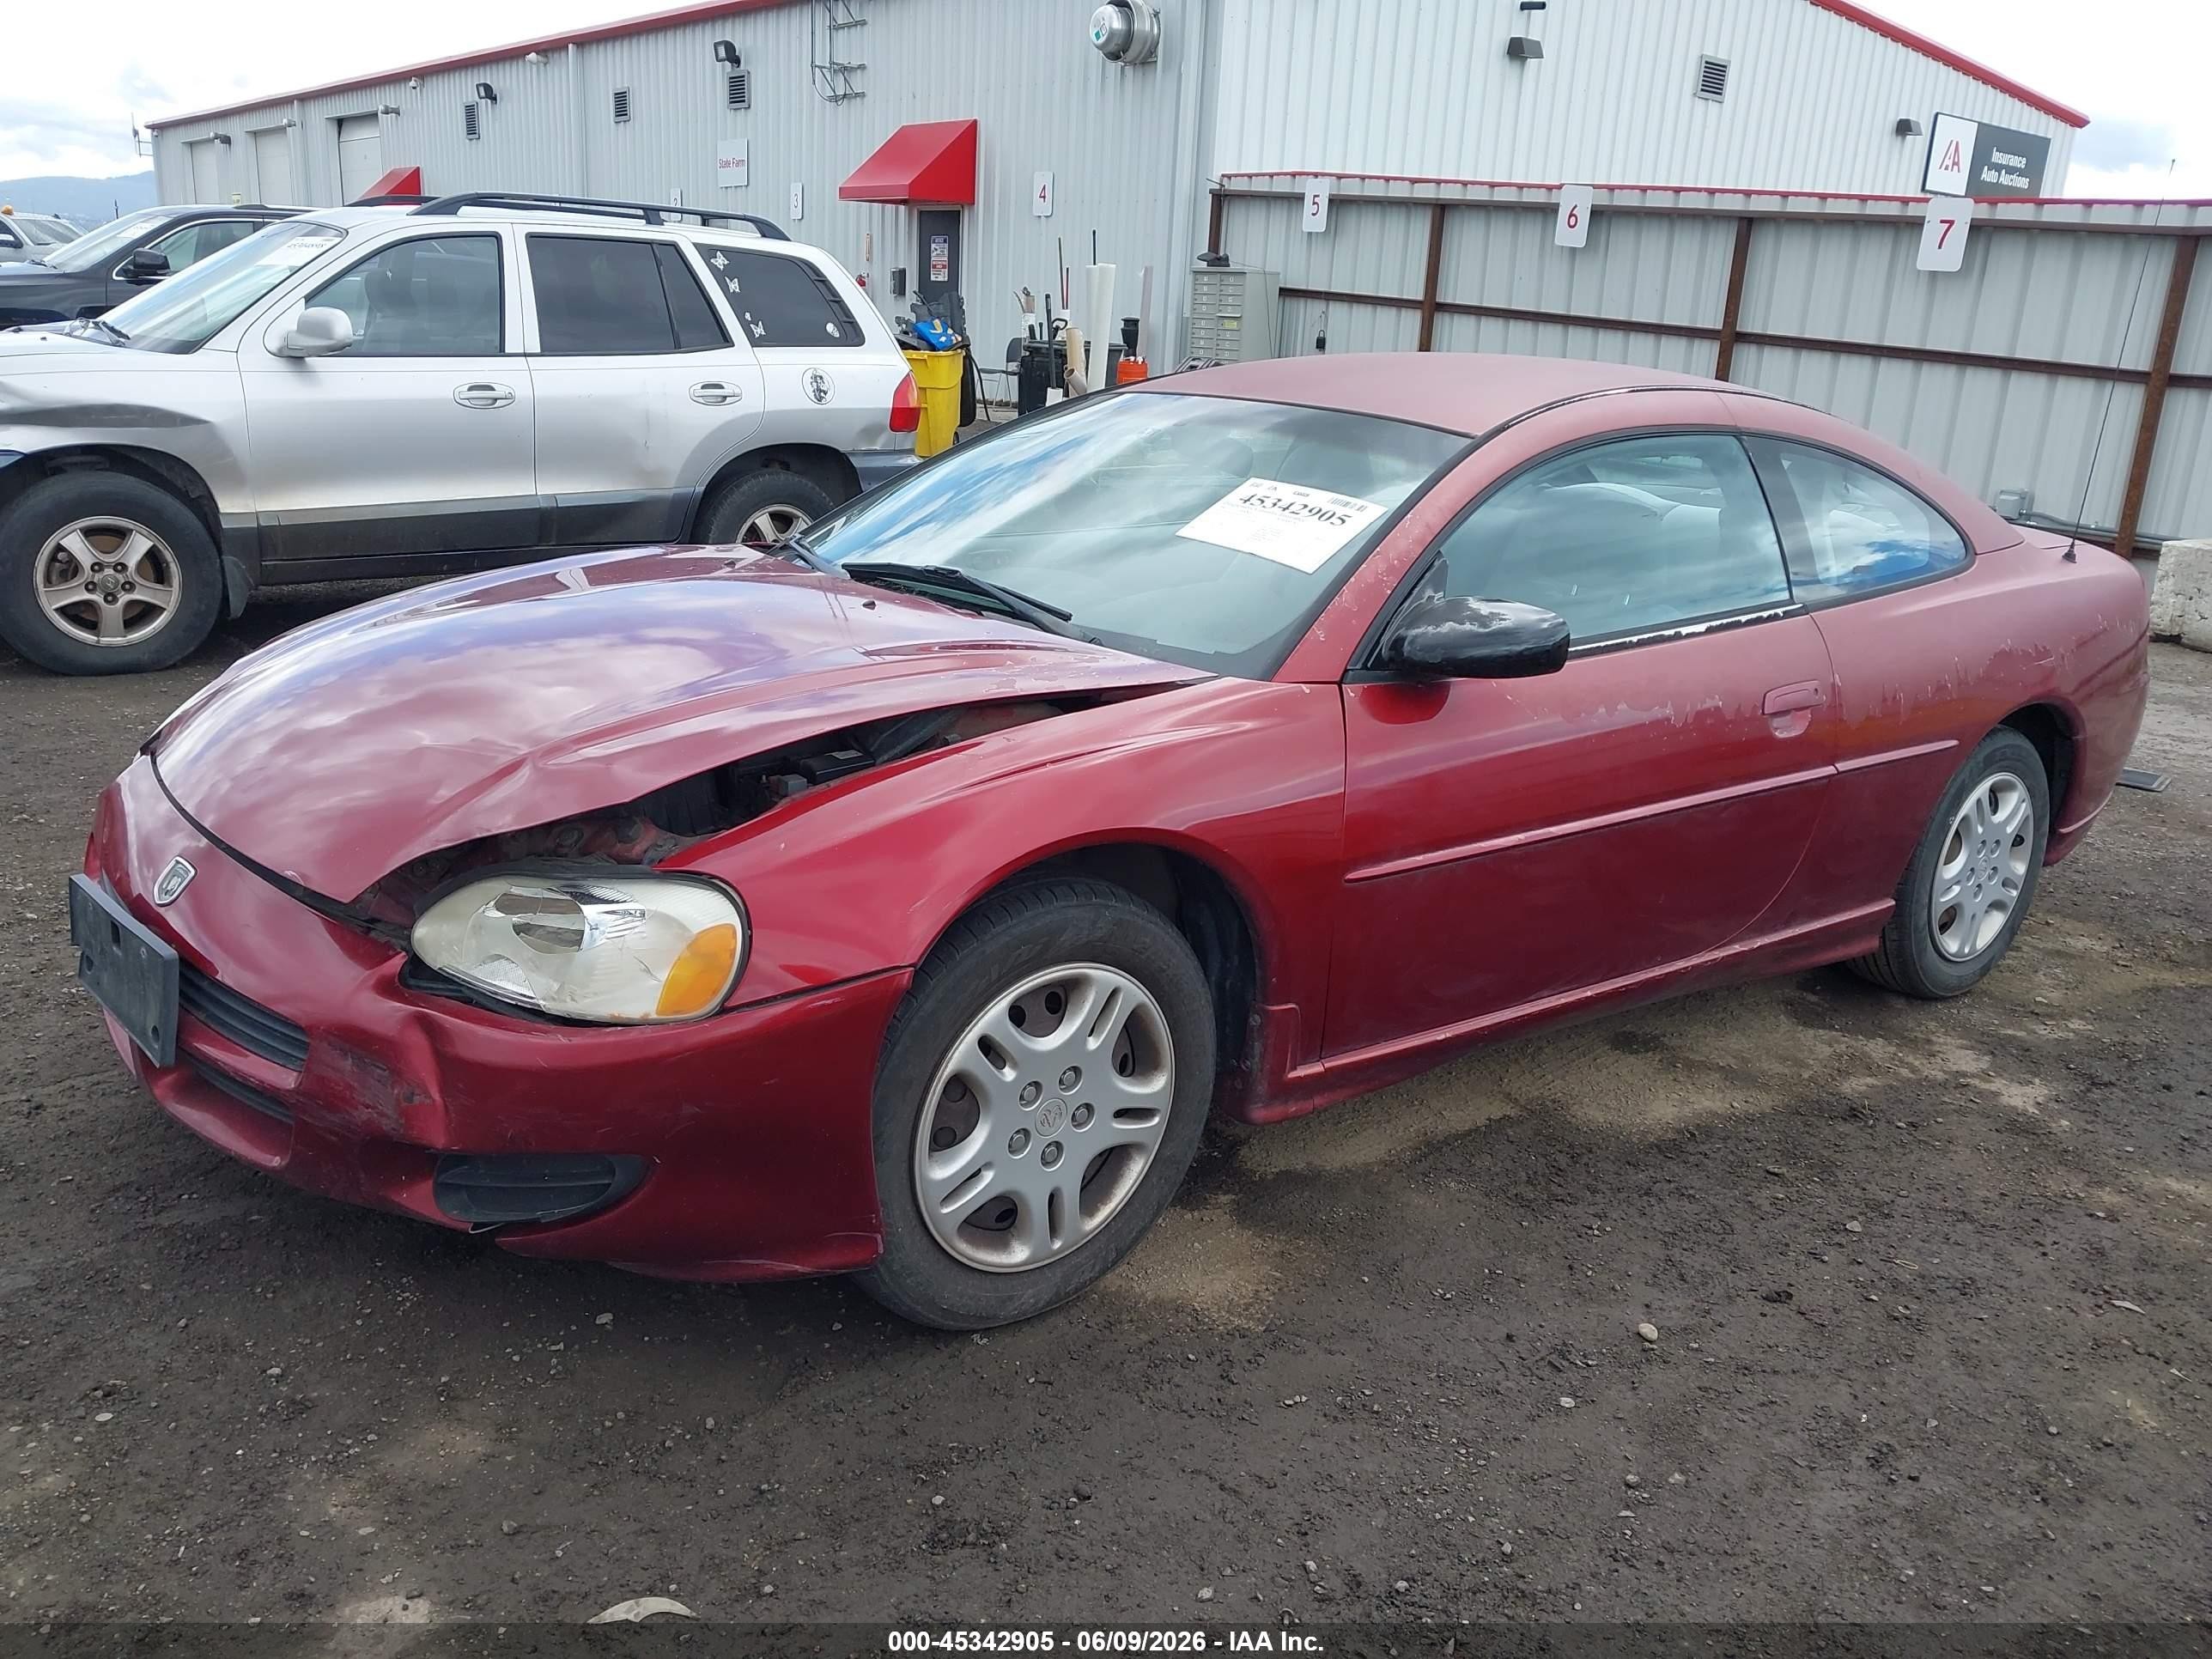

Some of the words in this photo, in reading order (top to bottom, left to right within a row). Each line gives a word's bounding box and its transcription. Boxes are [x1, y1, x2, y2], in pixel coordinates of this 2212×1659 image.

[718, 158, 732, 169] State
[732, 157, 746, 168] Farm
[1991, 146, 2027, 169] Insurance
[1980, 165, 1999, 184] Auto
[1998, 170, 2031, 190] Auctions
[793, 193, 799, 209] 3
[1038, 184, 1047, 204] 4
[1311, 194, 1321, 217] 5
[1566, 204, 1579, 229] 6
[1937, 219, 1956, 250] 7
[1239, 493, 1353, 526] 45342905
